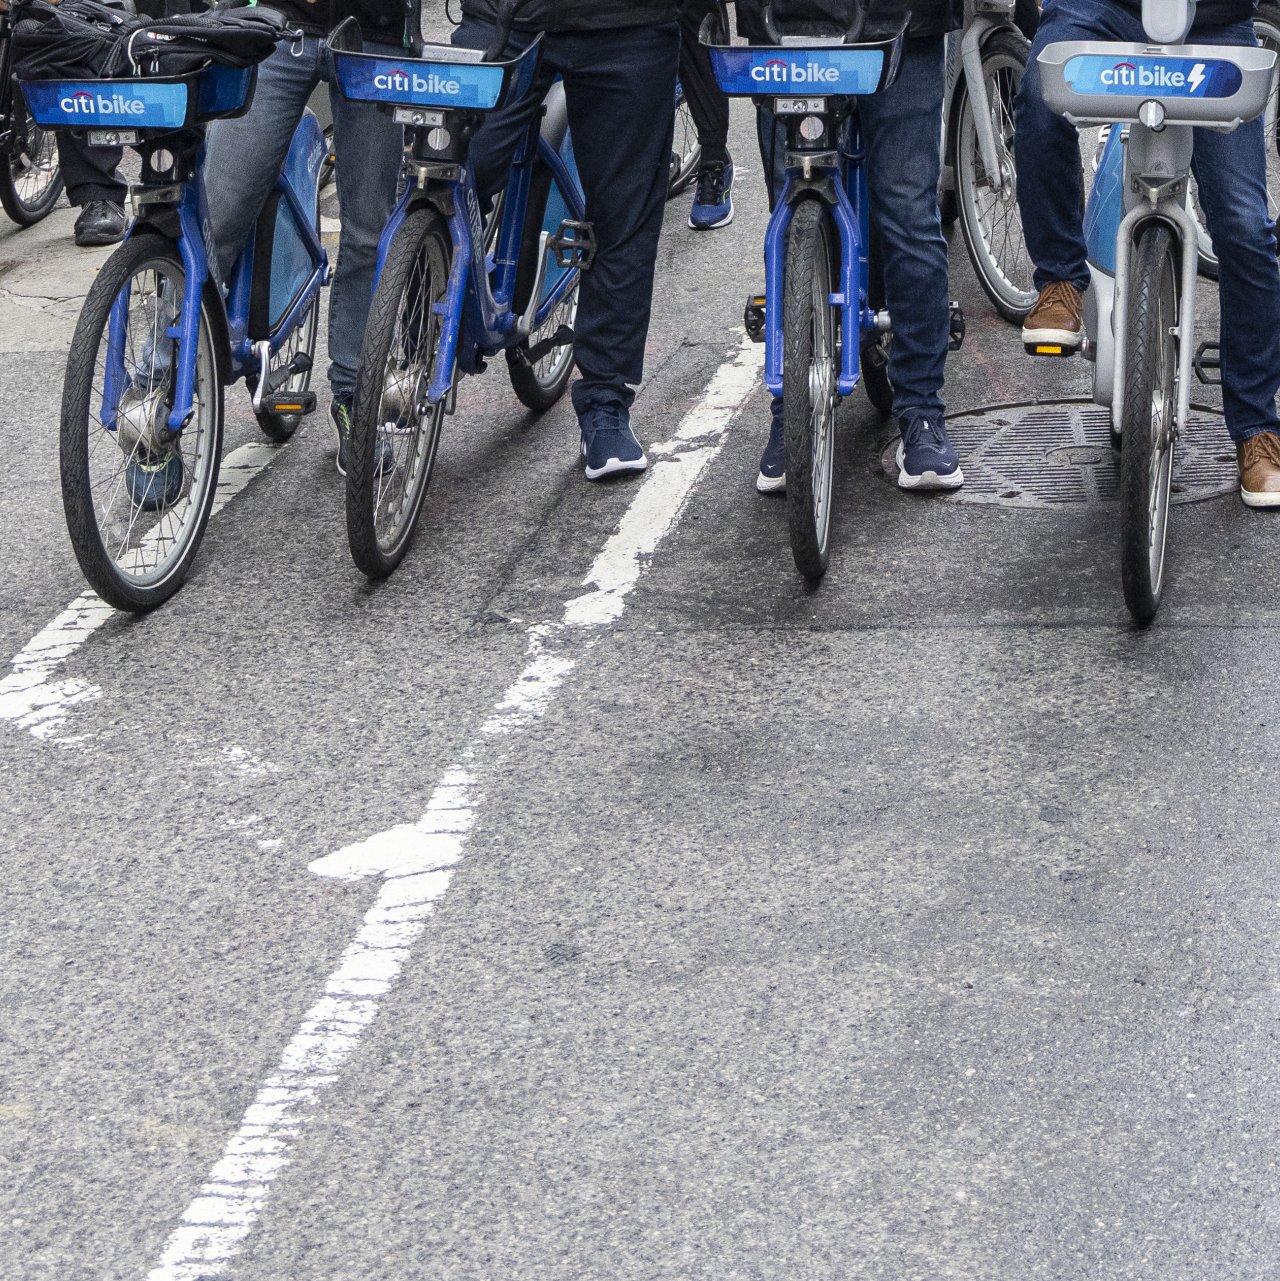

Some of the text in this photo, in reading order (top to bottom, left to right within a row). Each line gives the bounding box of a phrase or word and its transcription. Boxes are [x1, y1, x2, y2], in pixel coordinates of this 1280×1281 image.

[374, 70, 460, 94] citi bike
[751, 60, 839, 82] citi bike
[1100, 63, 1184, 86] citi bike
[61, 92, 145, 115] citi bike
